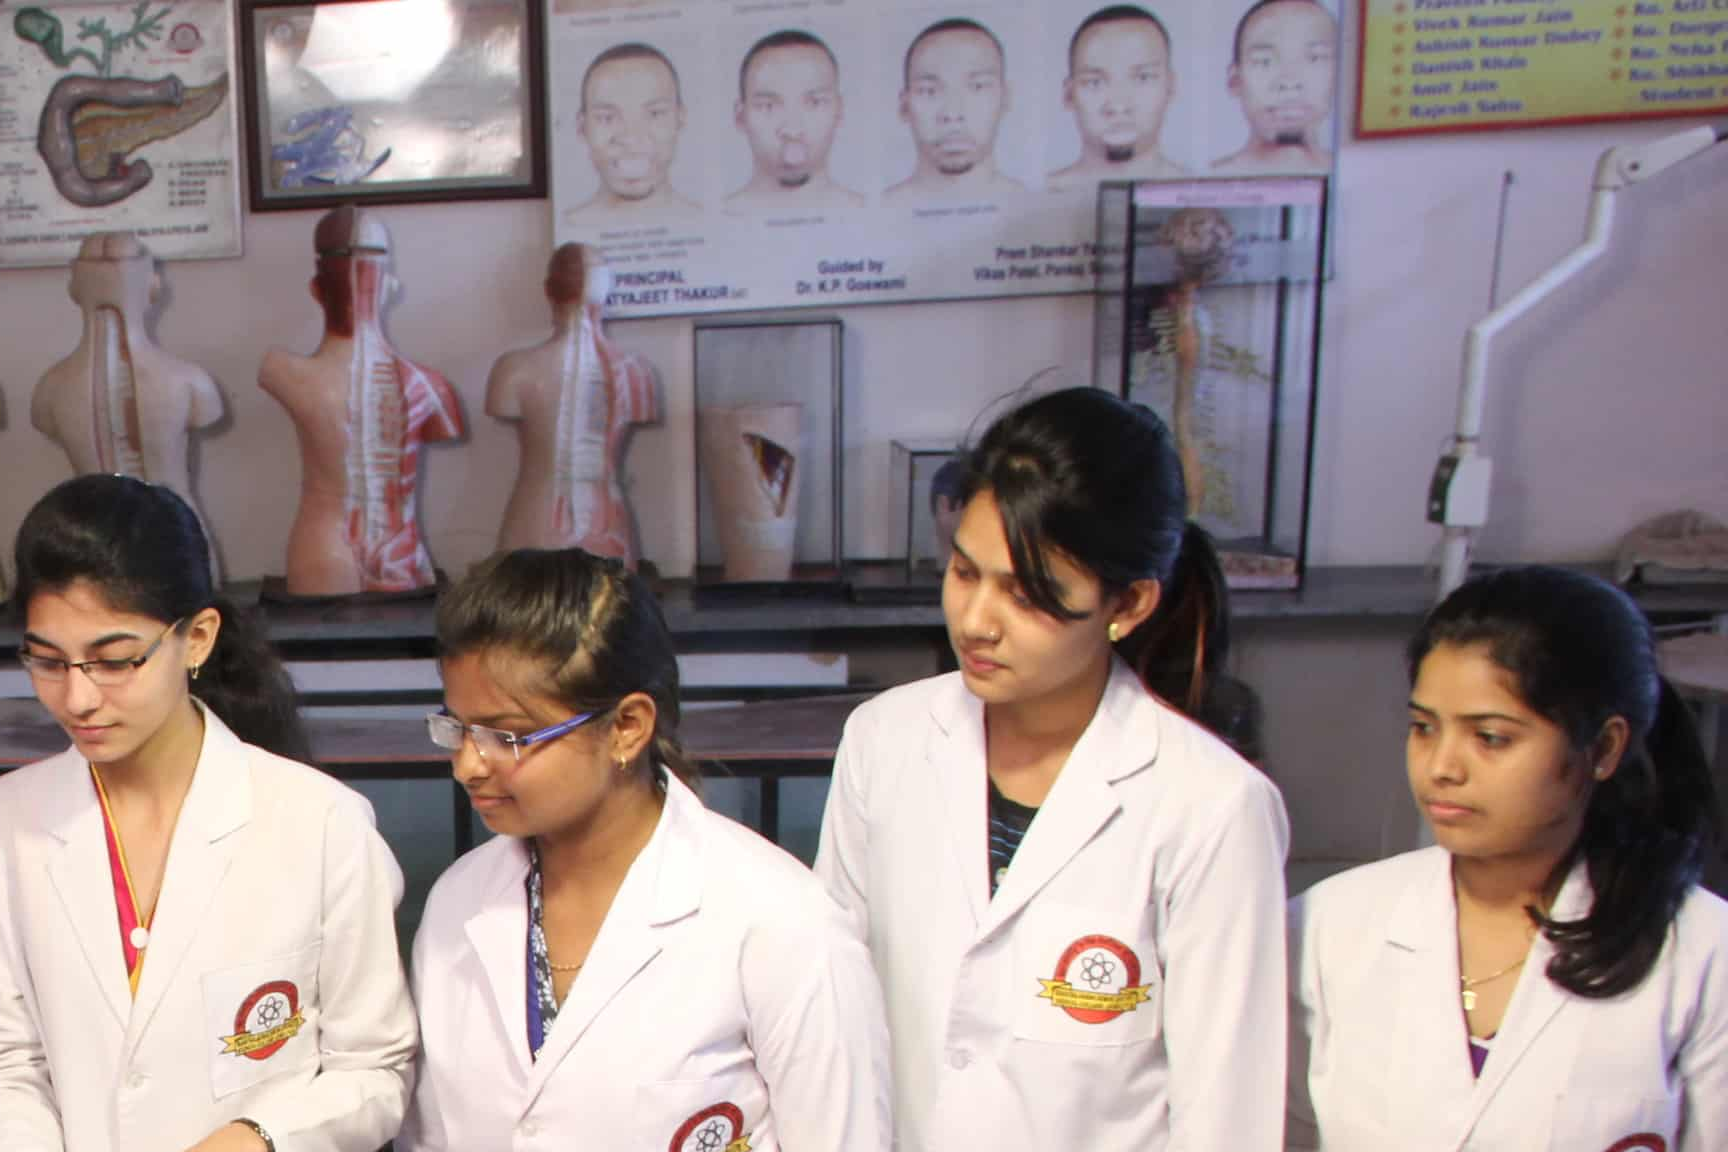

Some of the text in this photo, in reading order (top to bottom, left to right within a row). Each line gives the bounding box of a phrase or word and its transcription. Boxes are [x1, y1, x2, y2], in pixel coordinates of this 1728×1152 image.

[1467, 14, 1526, 28] Kumar
[1535, 10, 1572, 24] Jain
[1478, 33, 1536, 48] Kumar
[817, 258, 884, 275] Guided by
[614, 270, 685, 287] PRINCIPAL
[796, 280, 816, 295] Dr.
[846, 275, 906, 293] Goswami
[671, 286, 728, 302] THAKUR
